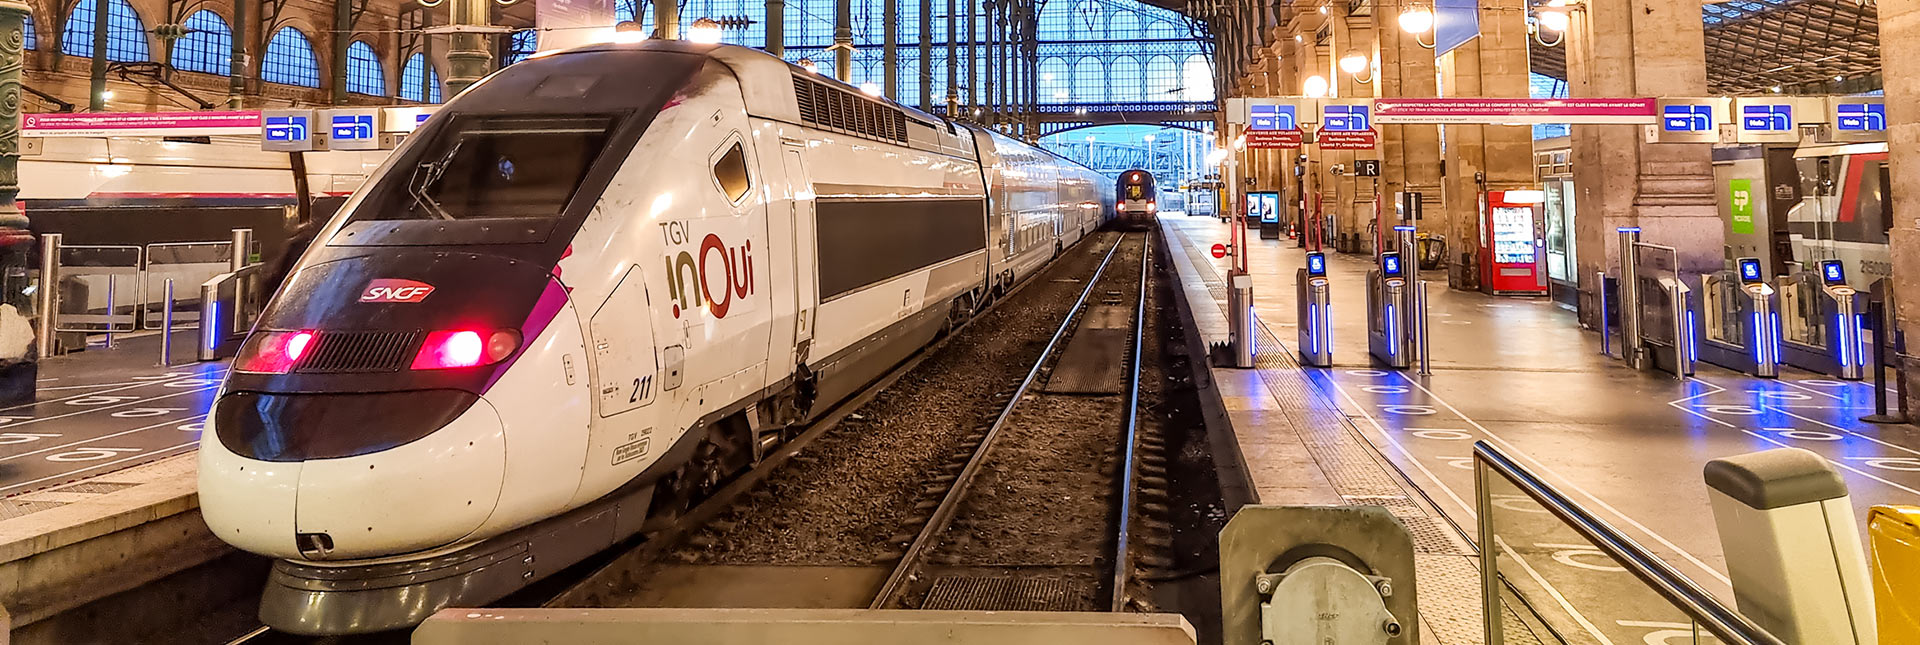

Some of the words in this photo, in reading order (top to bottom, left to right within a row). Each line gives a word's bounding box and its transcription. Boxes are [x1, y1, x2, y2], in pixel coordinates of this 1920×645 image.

[1366, 163, 1375, 176] R
[658, 220, 690, 246] TGV
[362, 286, 430, 300] SNCF
[629, 374, 652, 404] 211
